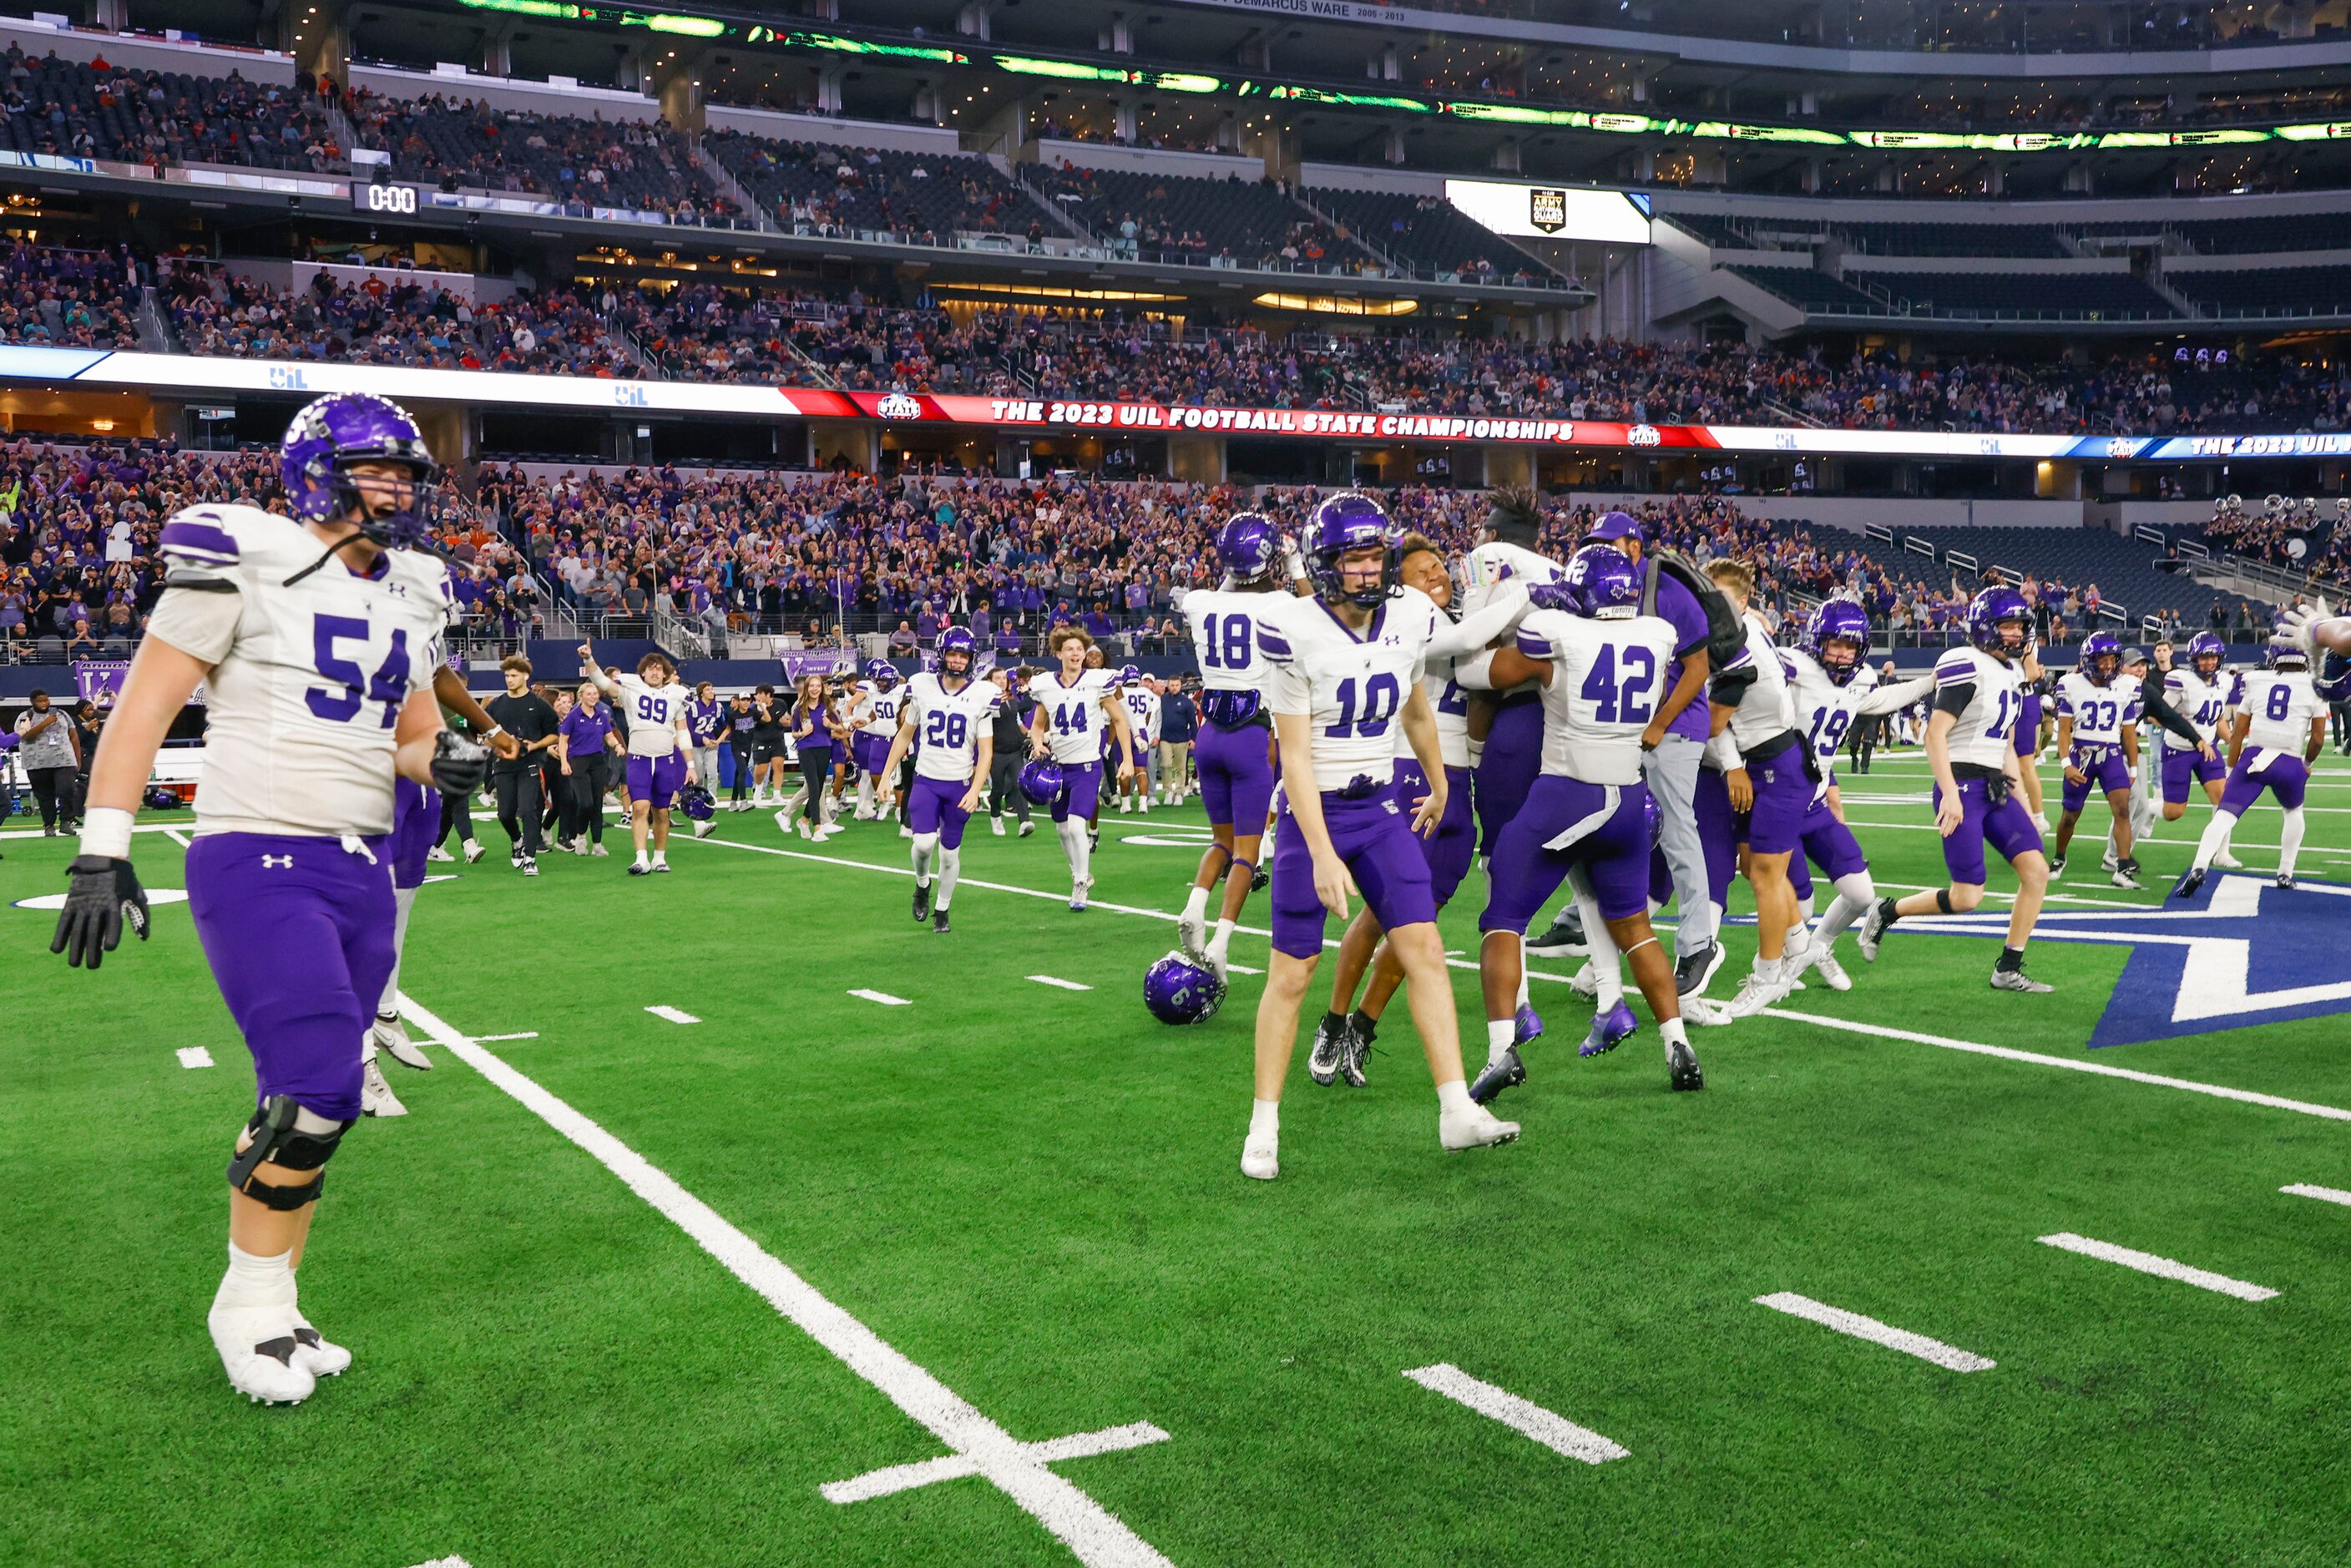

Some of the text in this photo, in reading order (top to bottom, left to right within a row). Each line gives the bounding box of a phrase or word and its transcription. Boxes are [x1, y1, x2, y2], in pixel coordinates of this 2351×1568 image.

[1311, 2, 1350, 17] WARE
[1384, 11, 1405, 22] 2013
[368, 185, 416, 214] 0:00
[991, 401, 1575, 442] THE 2023 UIL FOOTBALL STATE CHAMPIONSHIPS
[2190, 438, 2237, 455] THE
[2238, 436, 2296, 454] 2023
[2300, 435, 2339, 453] UIL
[1255, 539, 1274, 561] 18
[1203, 613, 1251, 670] 18
[305, 613, 411, 729] 54
[1580, 643, 1655, 724] 42
[638, 695, 668, 725] 99
[875, 701, 895, 720] 50
[1054, 701, 1088, 736] 44
[1128, 695, 1147, 714] 95
[1324, 672, 1400, 738] 10
[1984, 689, 2023, 740] 17
[2080, 701, 2118, 731] 33
[2192, 700, 2223, 726] 40
[2267, 684, 2292, 721] 8
[927, 710, 968, 749] 28
[1807, 706, 1849, 756] 19
[1171, 987, 1191, 1006] 6
